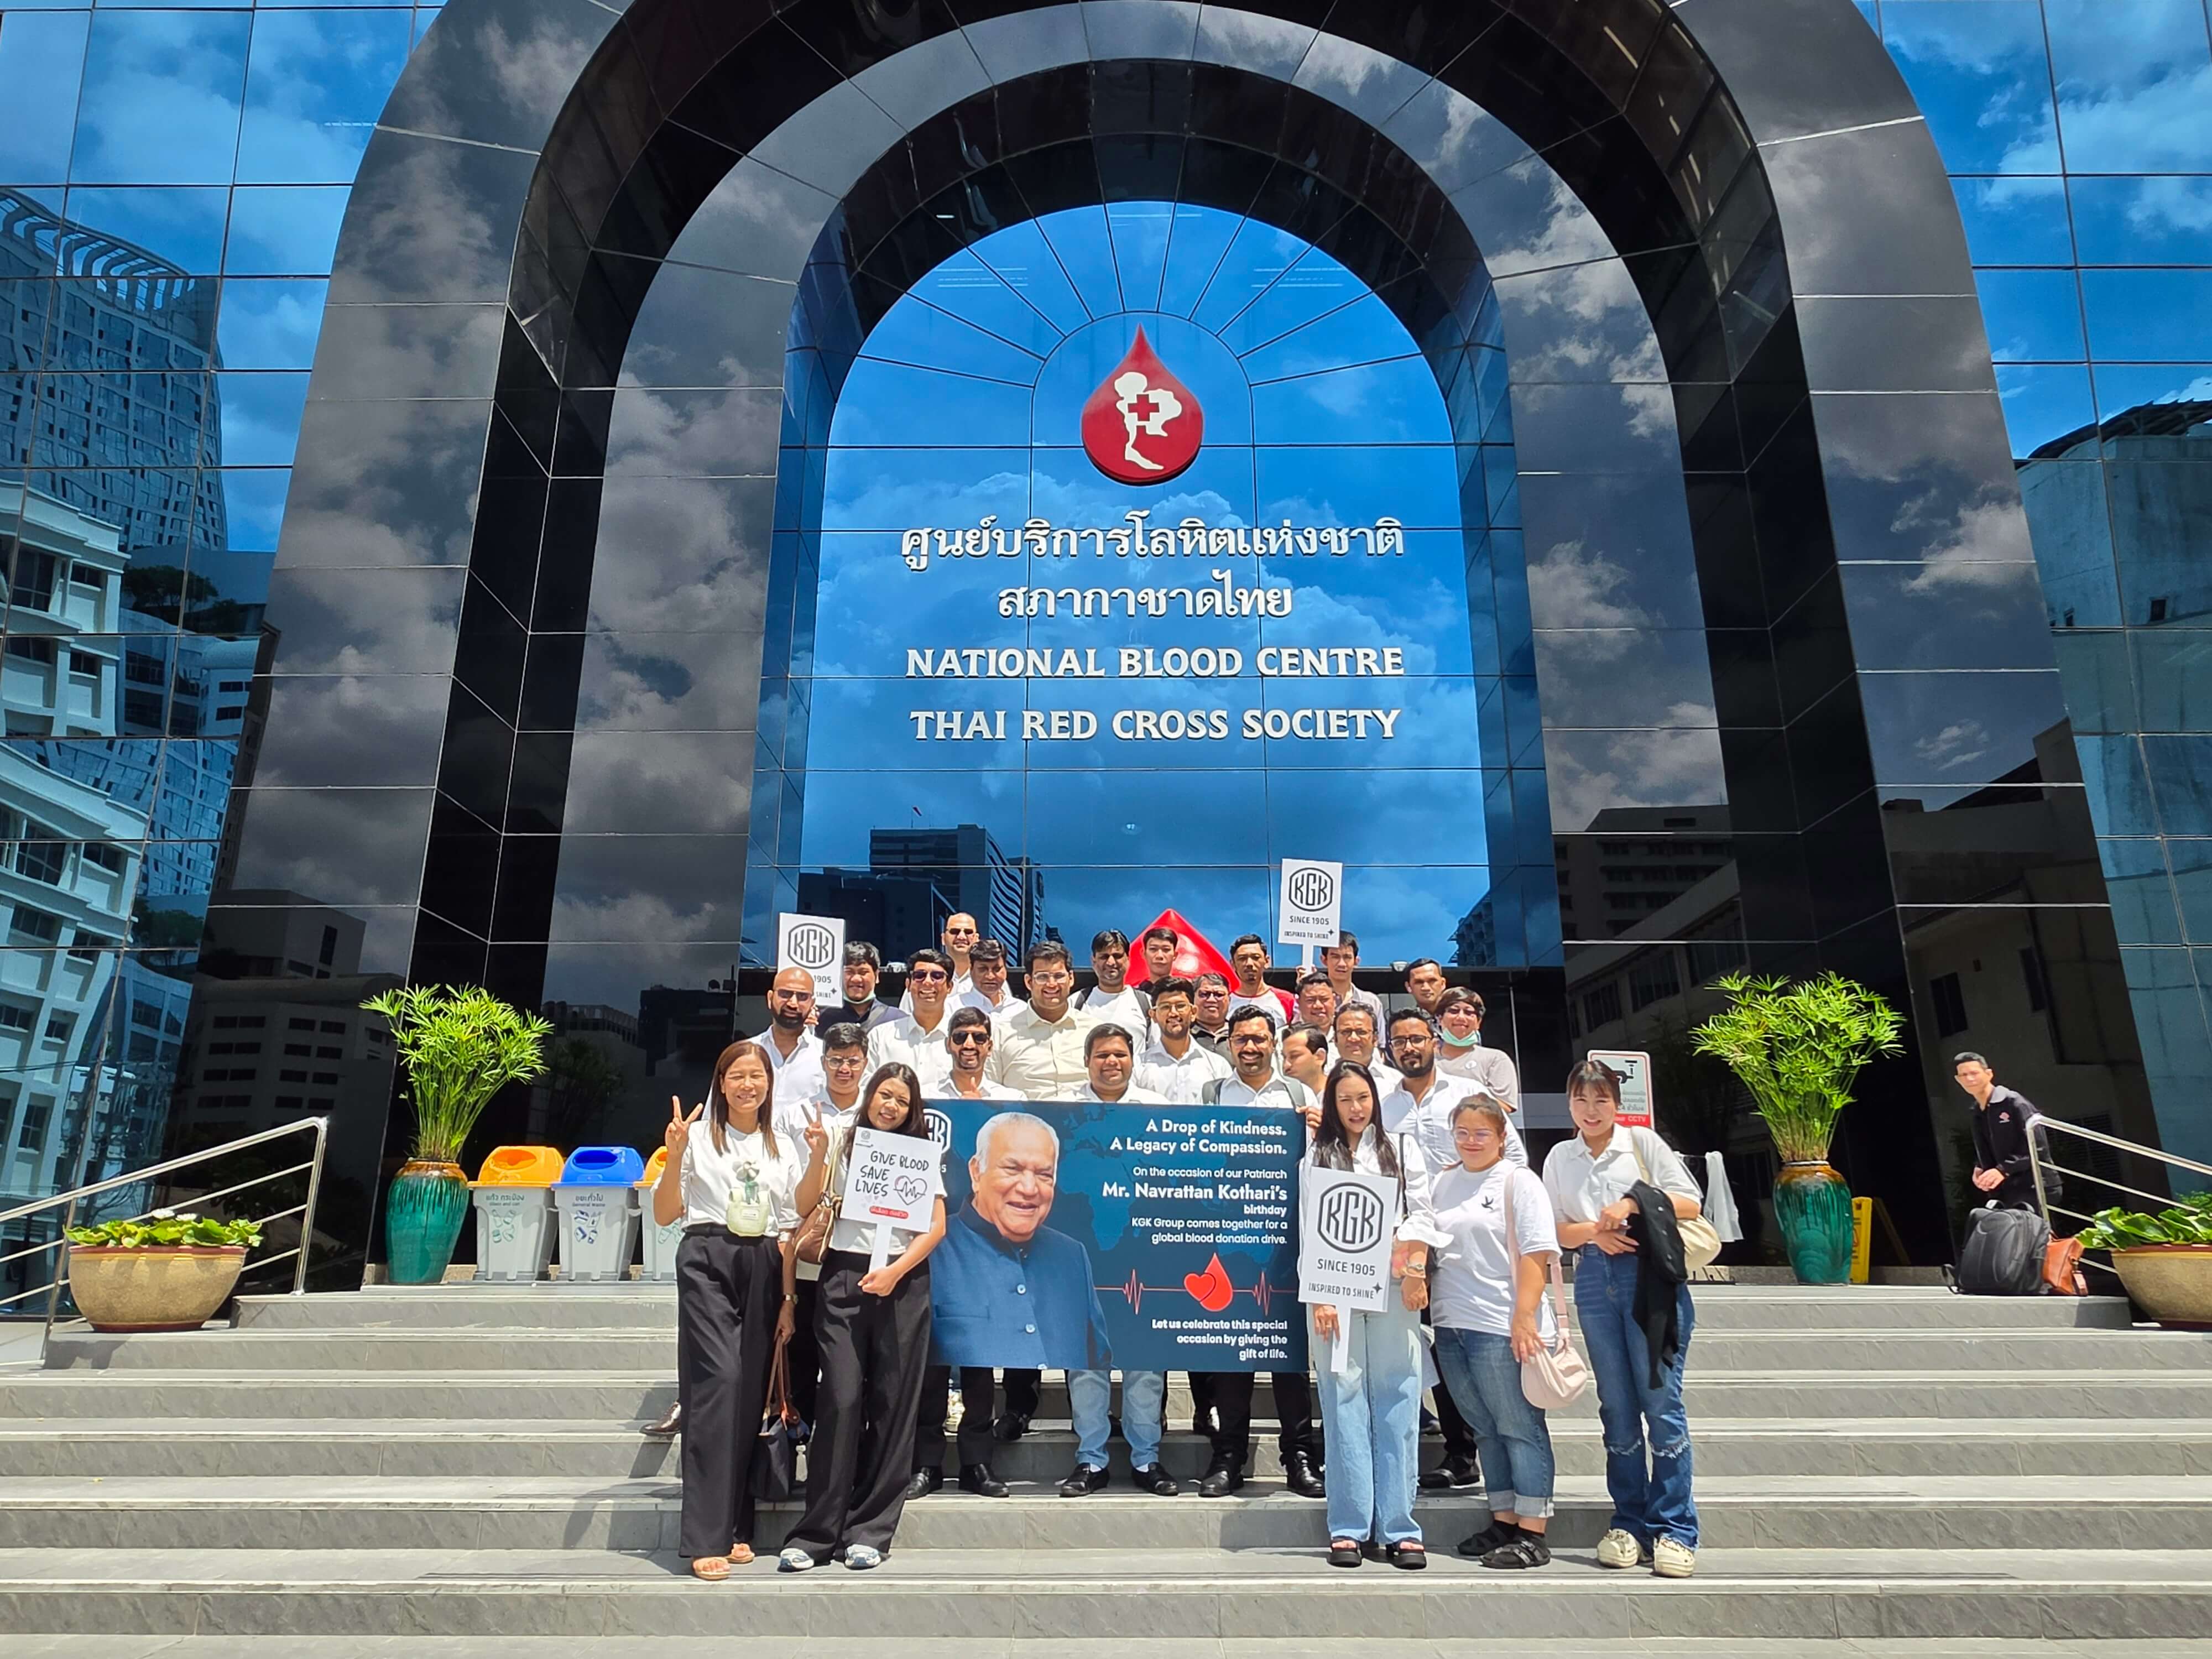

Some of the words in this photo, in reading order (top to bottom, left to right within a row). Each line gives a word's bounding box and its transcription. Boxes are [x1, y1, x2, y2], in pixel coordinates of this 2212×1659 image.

[901, 509, 1404, 571] ศูนย์บริการโลหิตแห่งชาติ
[998, 569, 1293, 618] สภากาชาดไทย
[905, 649, 1105, 677] NATIONAL
[1118, 648, 1242, 677] BLOOD
[1256, 647, 1404, 676] CENTRE
[910, 710, 1006, 740] THAI
[1022, 710, 1098, 740] RED
[1112, 709, 1229, 739] CROSS
[1242, 708, 1401, 739] SOCIETY
[1295, 873, 1327, 906] KGK
[1290, 915, 1310, 924] SINCE
[794, 929, 829, 963] KGK
[814, 975, 832, 984] 1905
[1145, 1118, 1159, 1133] A
[1162, 1119, 1197, 1136] Drop
[1201, 1119, 1217, 1134] of
[1219, 1120, 1287, 1136] Kindness.
[1109, 1136, 1123, 1151] A
[1126, 1137, 1177, 1155] Legacy
[1180, 1138, 1196, 1152] of
[1198, 1139, 1287, 1156] Compassion.
[871, 1151, 897, 1166] GIVE
[900, 1155, 929, 1171] BLOOD
[860, 1165, 890, 1181] SAVE
[1133, 1166, 1148, 1177] On
[1149, 1167, 1166, 1177] the
[1167, 1167, 1213, 1178] occasion
[1214, 1167, 1224, 1178] of
[1225, 1170, 1243, 1178] our
[1244, 1169, 1287, 1180] Patriarch
[855, 1179, 889, 1197] LIVES
[1102, 1181, 1130, 1198] Mr.
[1135, 1182, 1213, 1199] Navrattan
[1218, 1183, 1288, 1201] Kothari's
[1243, 1204, 1287, 1217] birthday
[1326, 1191, 1375, 1244] KGK
[1131, 1217, 1152, 1227] KGK
[1154, 1218, 1185, 1230] Group
[1186, 1220, 1220, 1229] comes
[1222, 1219, 1264, 1230] together
[1265, 1219, 1279, 1229] for
[1280, 1222, 1288, 1230] a
[1151, 1232, 1184, 1245] global
[1185, 1233, 1214, 1243] blood
[1215, 1233, 1260, 1244] donation
[1260, 1234, 1287, 1244] drive.
[1317, 1258, 1348, 1273] SINCE
[1350, 1262, 1375, 1276] 1905
[1308, 1282, 1340, 1295] INSPIRED
[1342, 1286, 1351, 1296] TO
[1353, 1288, 1374, 1300] SHINE
[1152, 1319, 1168, 1329] Let
[1182, 1319, 1230, 1330] celebrate
[1231, 1319, 1251, 1330] this
[1251, 1319, 1288, 1332] special
[1176, 1333, 1223, 1344] occasion
[1223, 1333, 1238, 1347] by
[1237, 1333, 1270, 1347] giving
[1270, 1334, 1288, 1344] the
[1239, 1348, 1257, 1361] gift
[1258, 1348, 1269, 1359] of
[1269, 1348, 1288, 1359] life.
